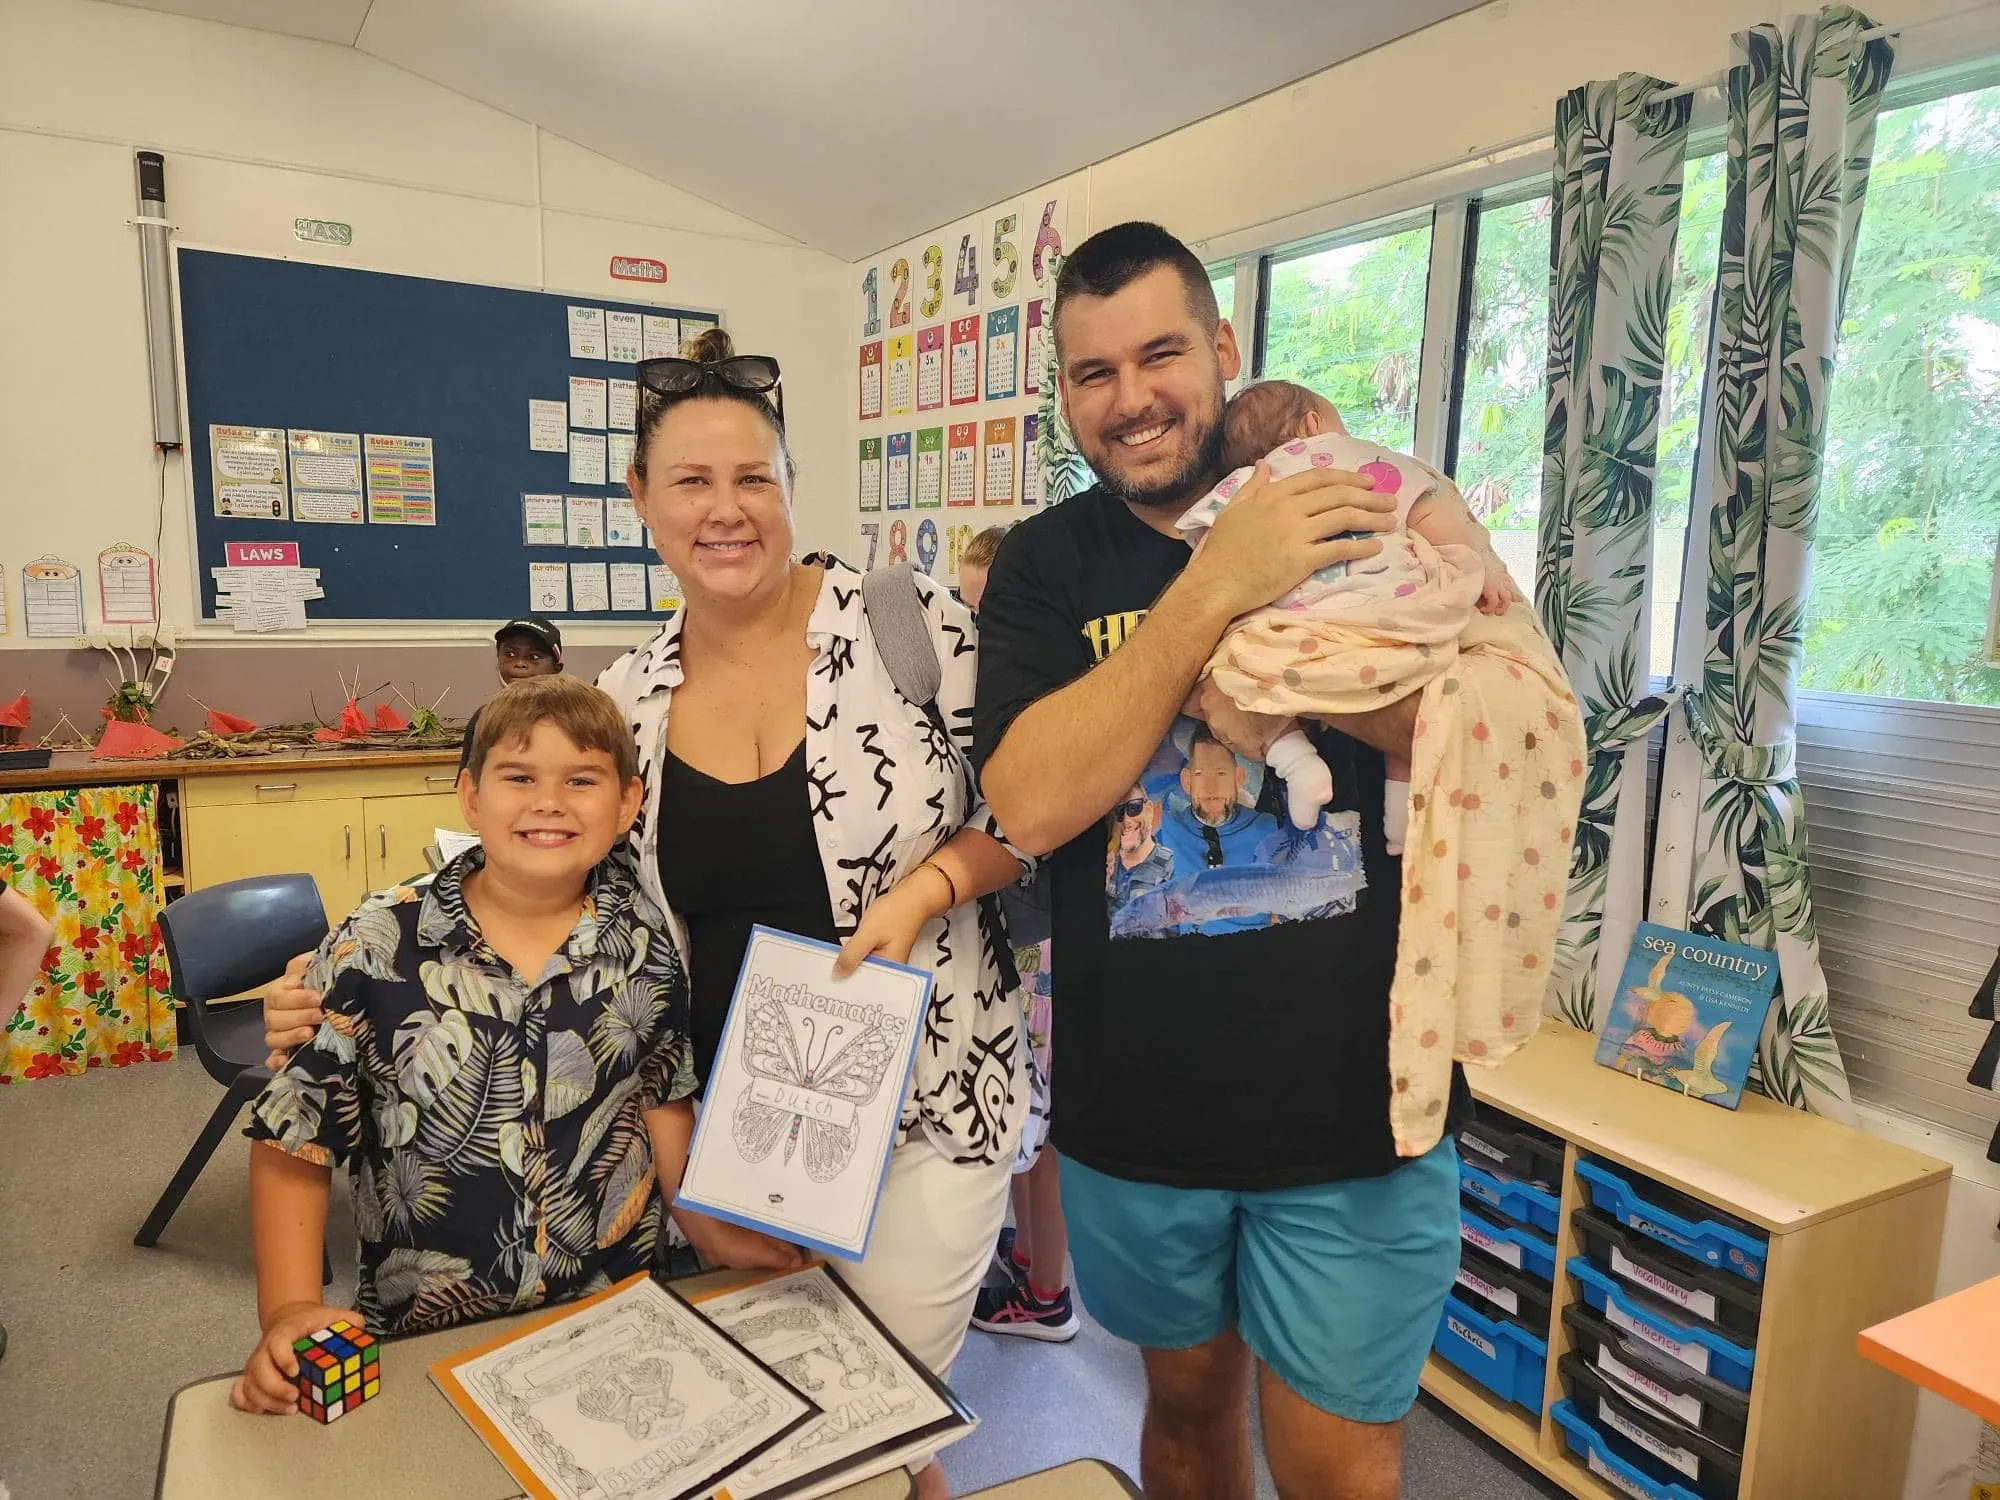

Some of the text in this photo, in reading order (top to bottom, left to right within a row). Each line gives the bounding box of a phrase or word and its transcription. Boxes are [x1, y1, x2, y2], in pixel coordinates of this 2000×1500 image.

[992, 213, 1018, 299] 5
[1033, 200, 1062, 288] 6
[613, 259, 663, 279] Maths
[920, 244, 944, 319] 3
[953, 234, 979, 306] 4
[862, 267, 881, 337] 1
[891, 258, 911, 329] 2
[576, 309, 596, 320] digit
[613, 314, 636, 323] even
[652, 319, 670, 329] odd
[370, 437, 394, 446] Rules
[404, 440, 426, 448] Laws
[572, 435, 605, 444] equation
[991, 447, 1006, 459] 11x
[572, 500, 598, 508] survey
[239, 548, 285, 561] LAWS
[861, 523, 879, 571] 7
[916, 519, 938, 577] 9
[531, 564, 564, 572] duration
[1642, 935, 1768, 981] sea country
[750, 973, 906, 1034] Mathematics
[1719, 991, 1753, 1005] CAMERON
[774, 1087, 833, 1117] Dutch
[1632, 1263, 1688, 1304] Vocabulary
[1632, 1319, 1681, 1356] Fluency
[1627, 1368, 1669, 1403] Spelling
[1614, 1413, 1683, 1463] Extra copies
